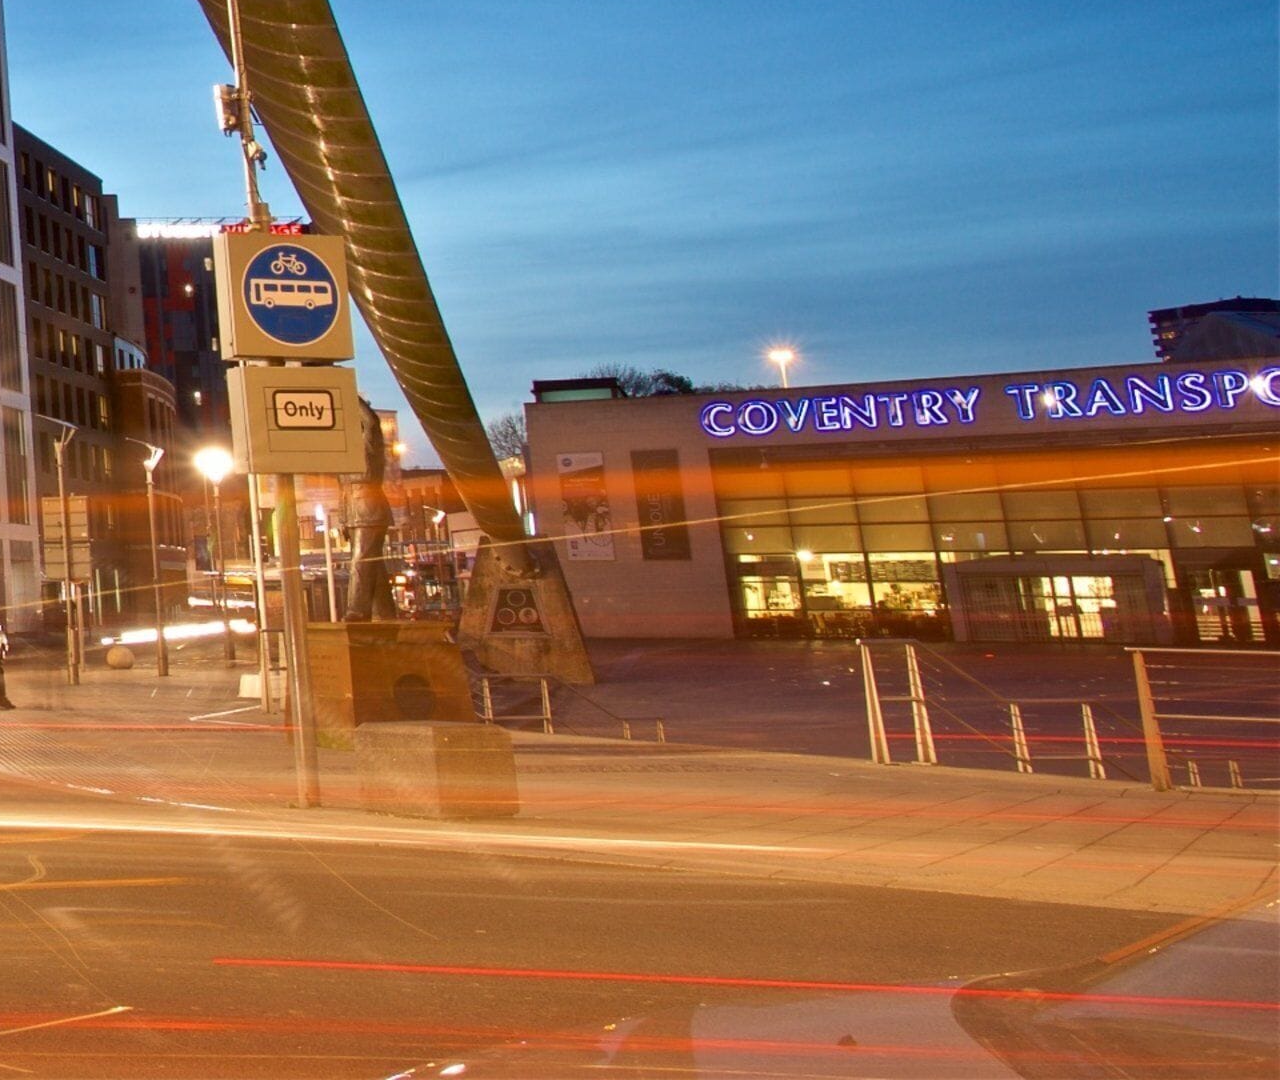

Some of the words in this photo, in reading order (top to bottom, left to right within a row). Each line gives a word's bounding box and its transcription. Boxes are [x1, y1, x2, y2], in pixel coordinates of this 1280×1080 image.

[284, 400, 325, 420] Only
[699, 387, 981, 438] COVENTRY
[1006, 367, 1280, 420] TRANSPO
